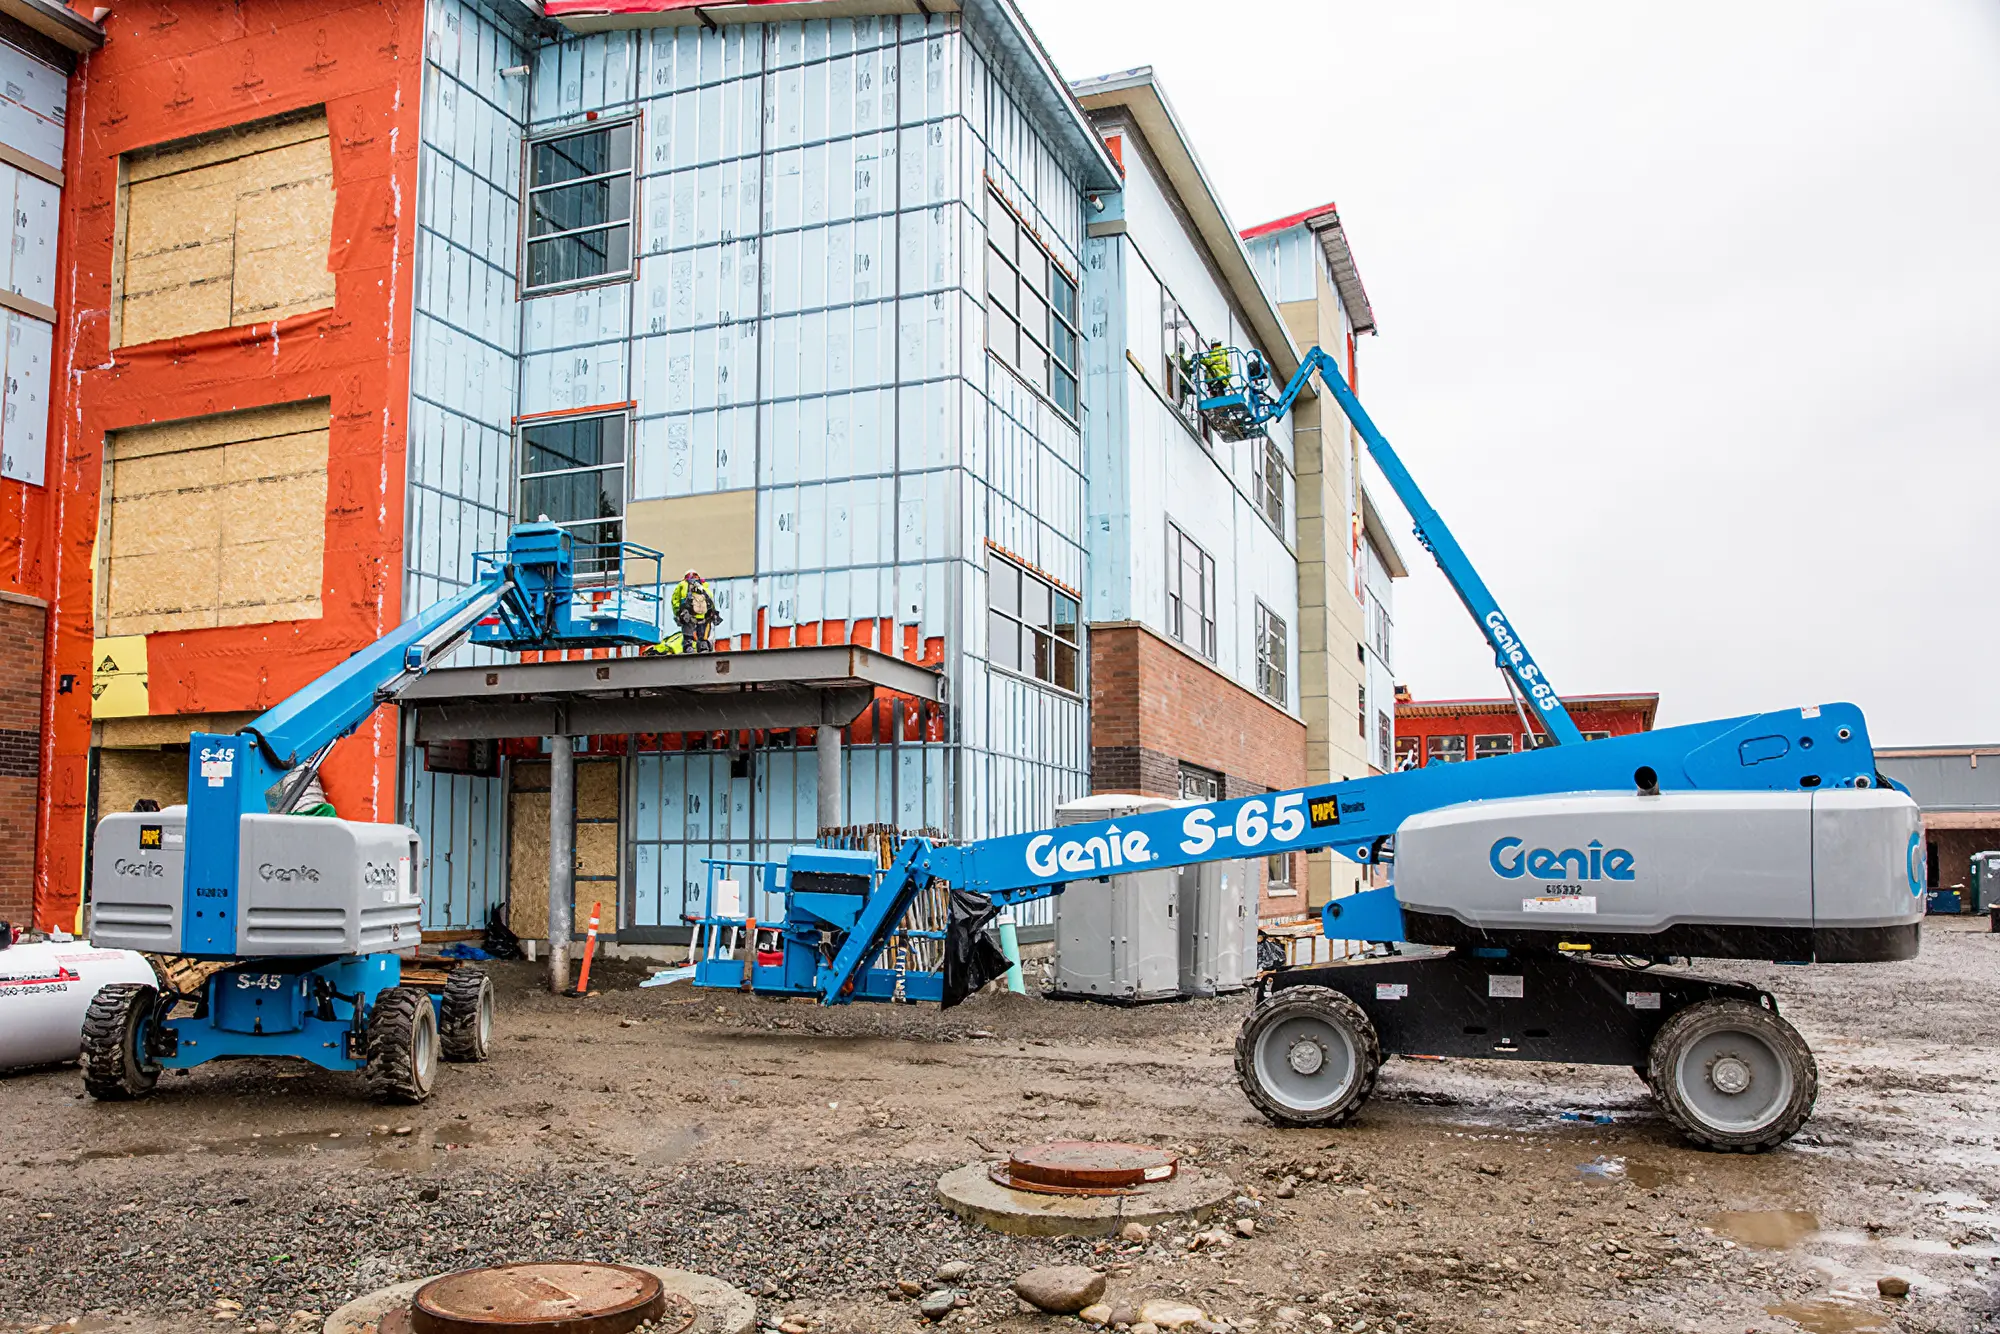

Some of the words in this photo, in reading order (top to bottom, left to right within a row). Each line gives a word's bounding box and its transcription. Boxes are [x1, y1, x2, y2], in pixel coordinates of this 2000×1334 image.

[1485, 610, 1524, 666] Genie
[1518, 664, 1560, 711] S-65
[200, 748, 235, 761] S-45
[1025, 824, 1151, 878] Genie
[1179, 792, 1305, 855] S-65
[1489, 836, 1636, 881] Genie
[237, 973, 282, 990] S-45
